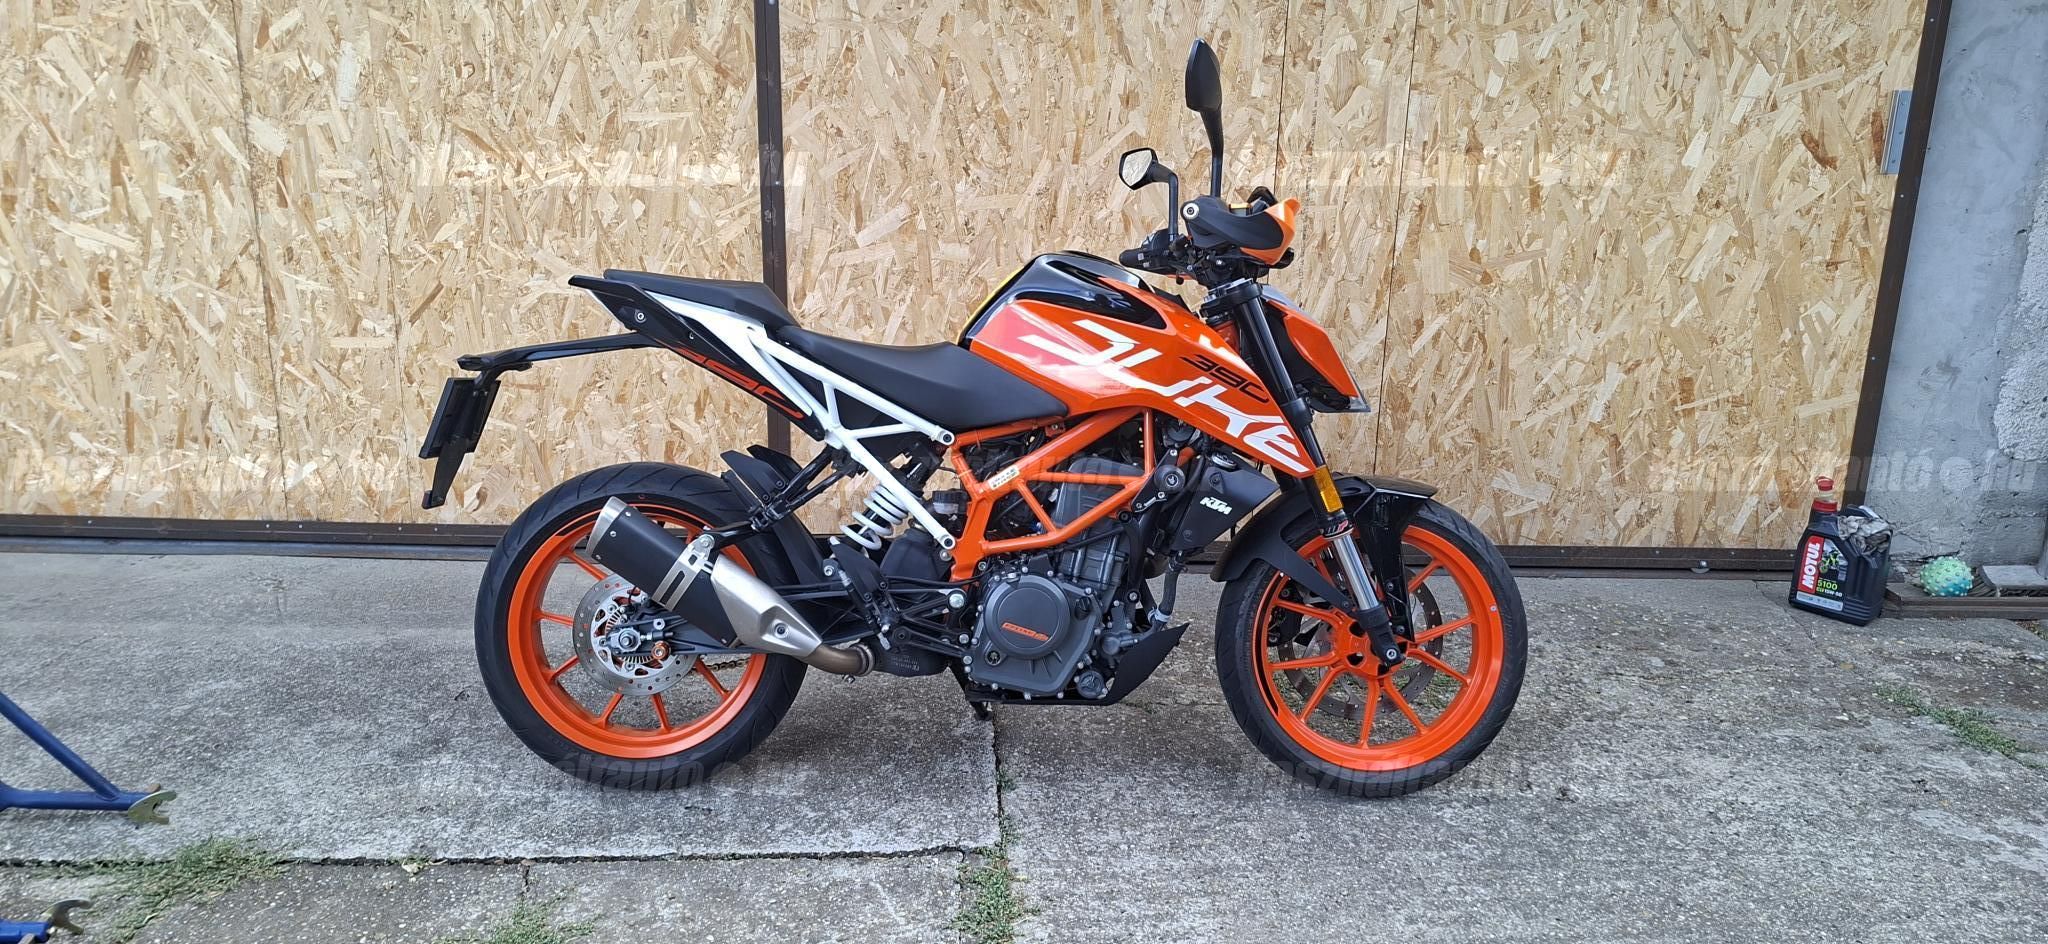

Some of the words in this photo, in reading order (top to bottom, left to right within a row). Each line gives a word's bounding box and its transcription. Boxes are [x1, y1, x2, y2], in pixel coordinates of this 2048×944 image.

[1179, 354, 1270, 404] 390
[1200, 497, 1233, 515] KTM
[1801, 542, 1821, 589] MOTUL
[1817, 579, 1838, 591] 5100
